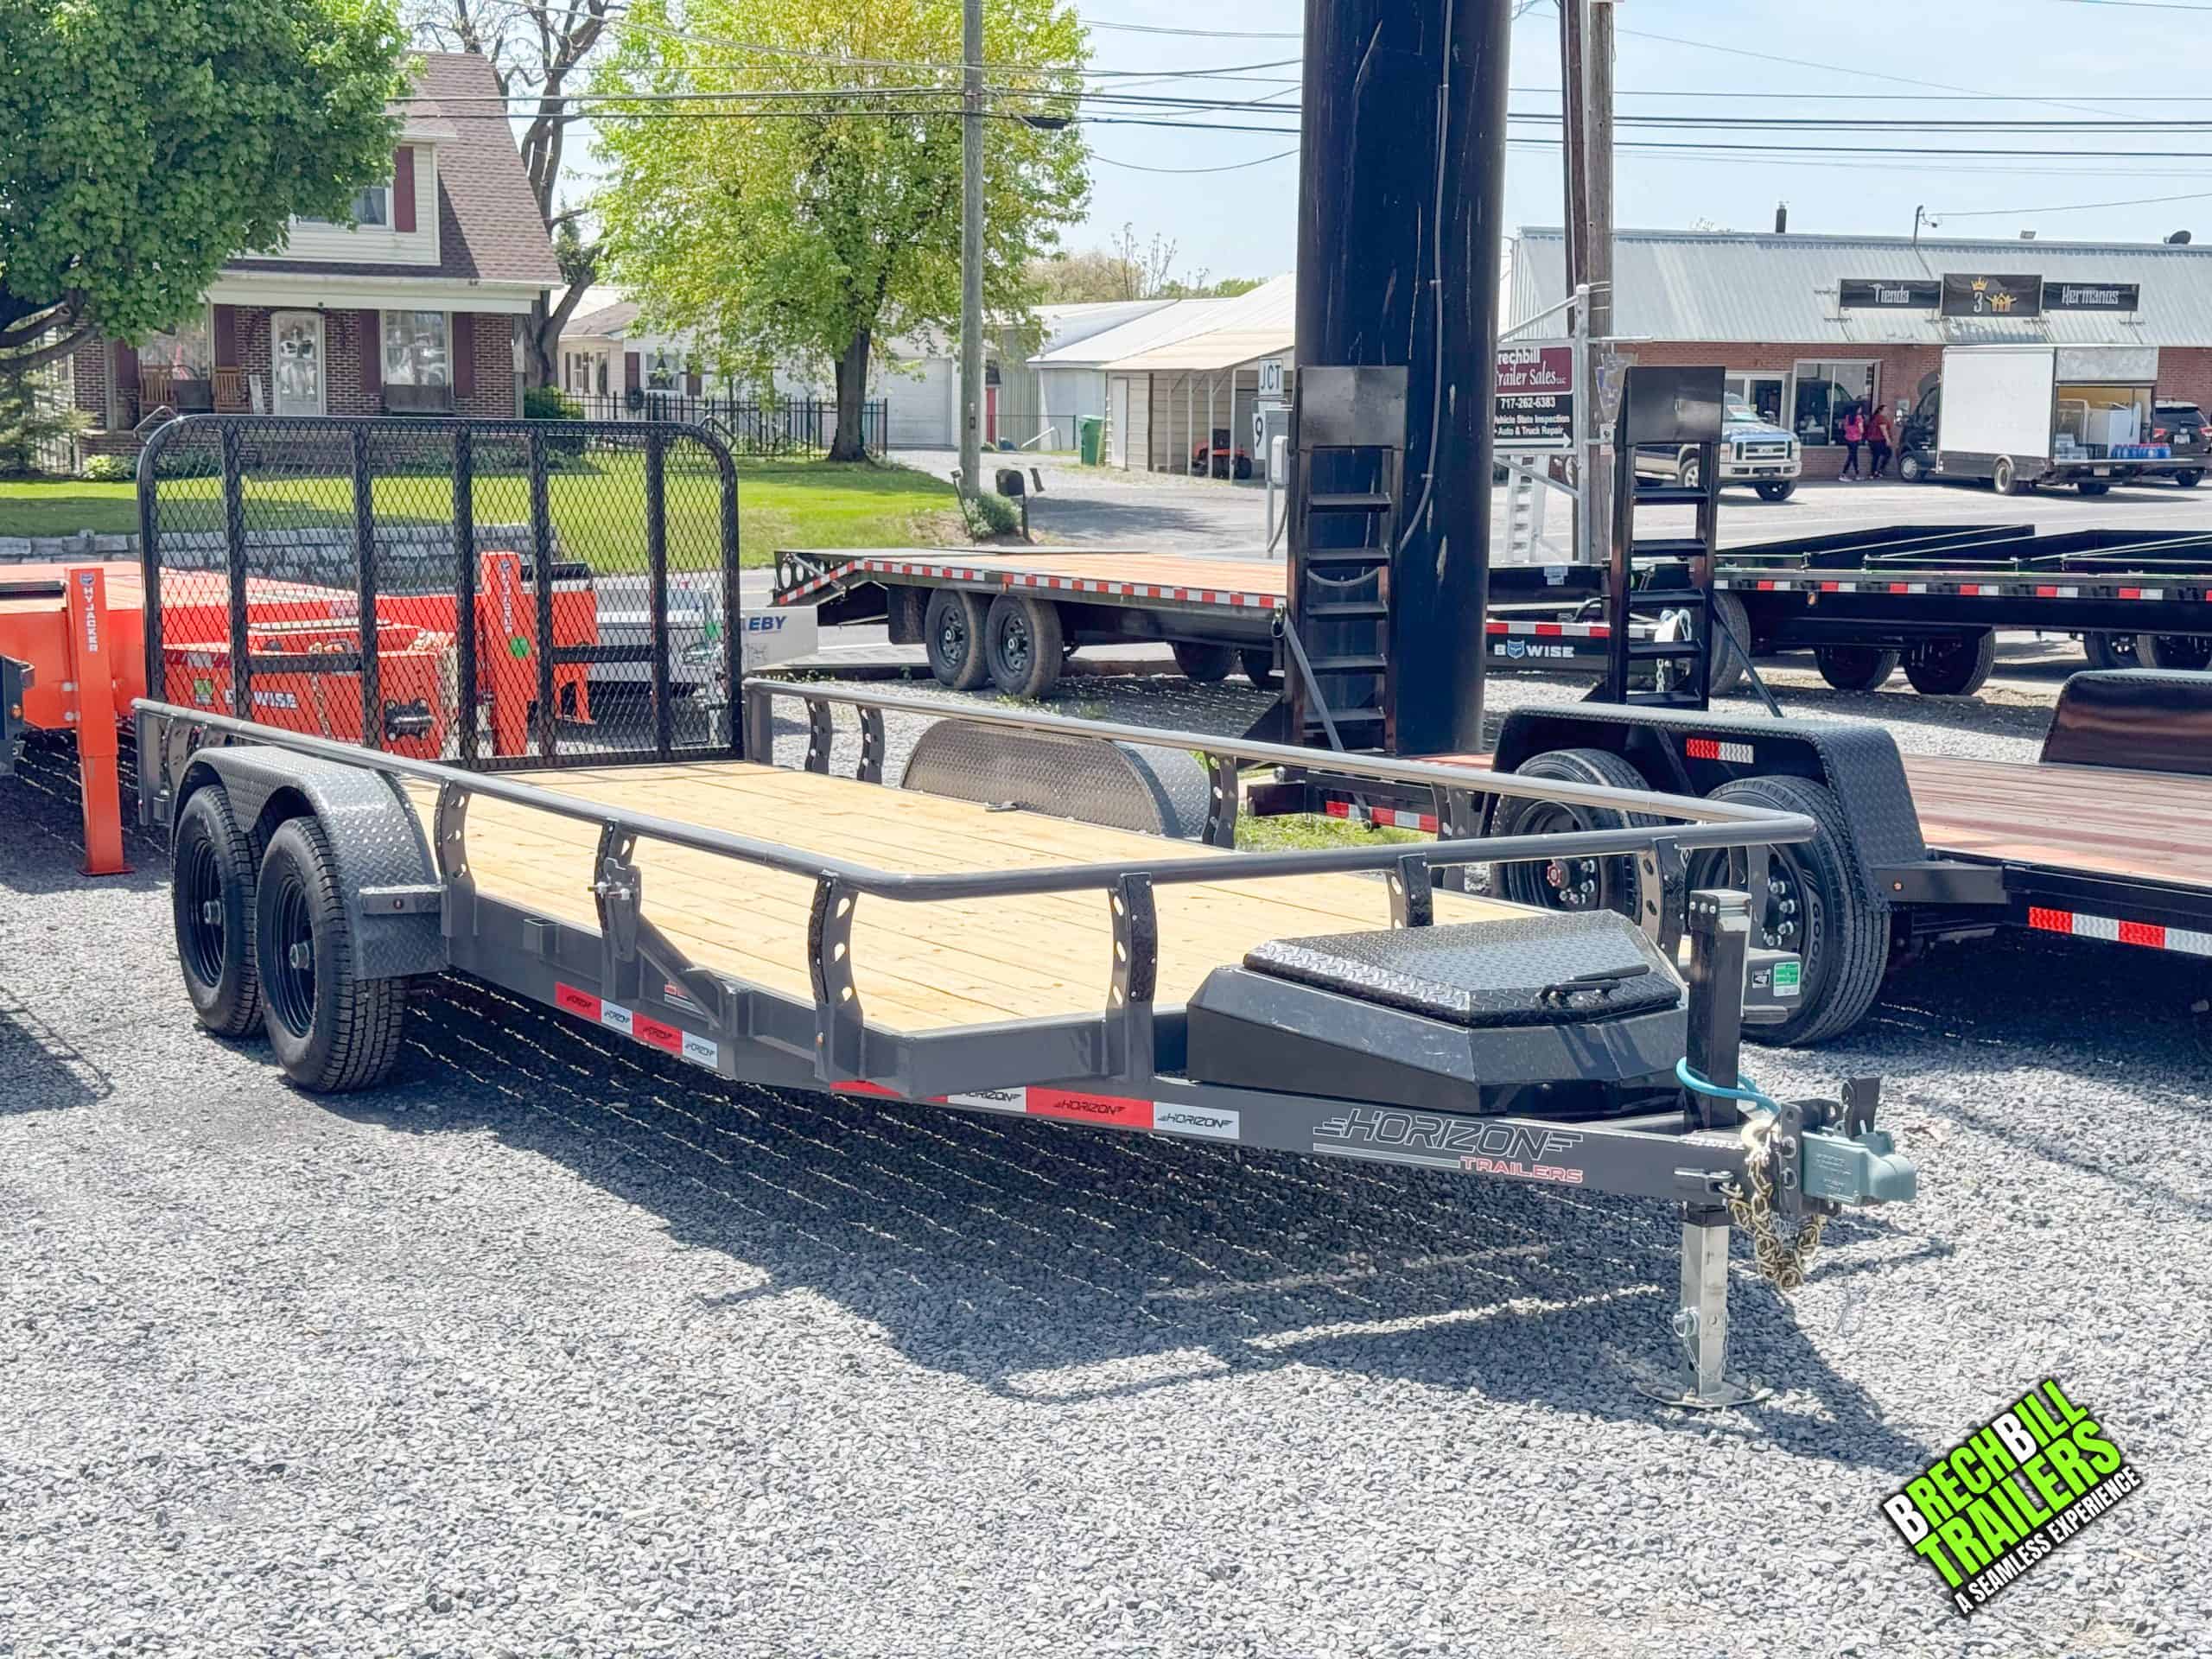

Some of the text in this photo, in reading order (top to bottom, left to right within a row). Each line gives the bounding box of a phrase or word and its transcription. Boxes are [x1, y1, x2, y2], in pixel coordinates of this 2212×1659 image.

[1867, 283, 2119, 313] Tienda 3 Hermanos
[1497, 346, 1541, 365] rechbill
[1261, 365, 1281, 390] JCT
[1529, 360, 1556, 385] Sales
[1534, 415, 1571, 425] Inspection
[83, 588, 99, 652] HYJACKER
[748, 615, 788, 631] EBY
[1059, 1099, 1119, 1116] HORIZON
[1163, 1112, 1225, 1128] HORIZON
[1343, 1108, 1553, 1160] HORIZON
[1459, 1156, 1584, 1184] TRAILERS
